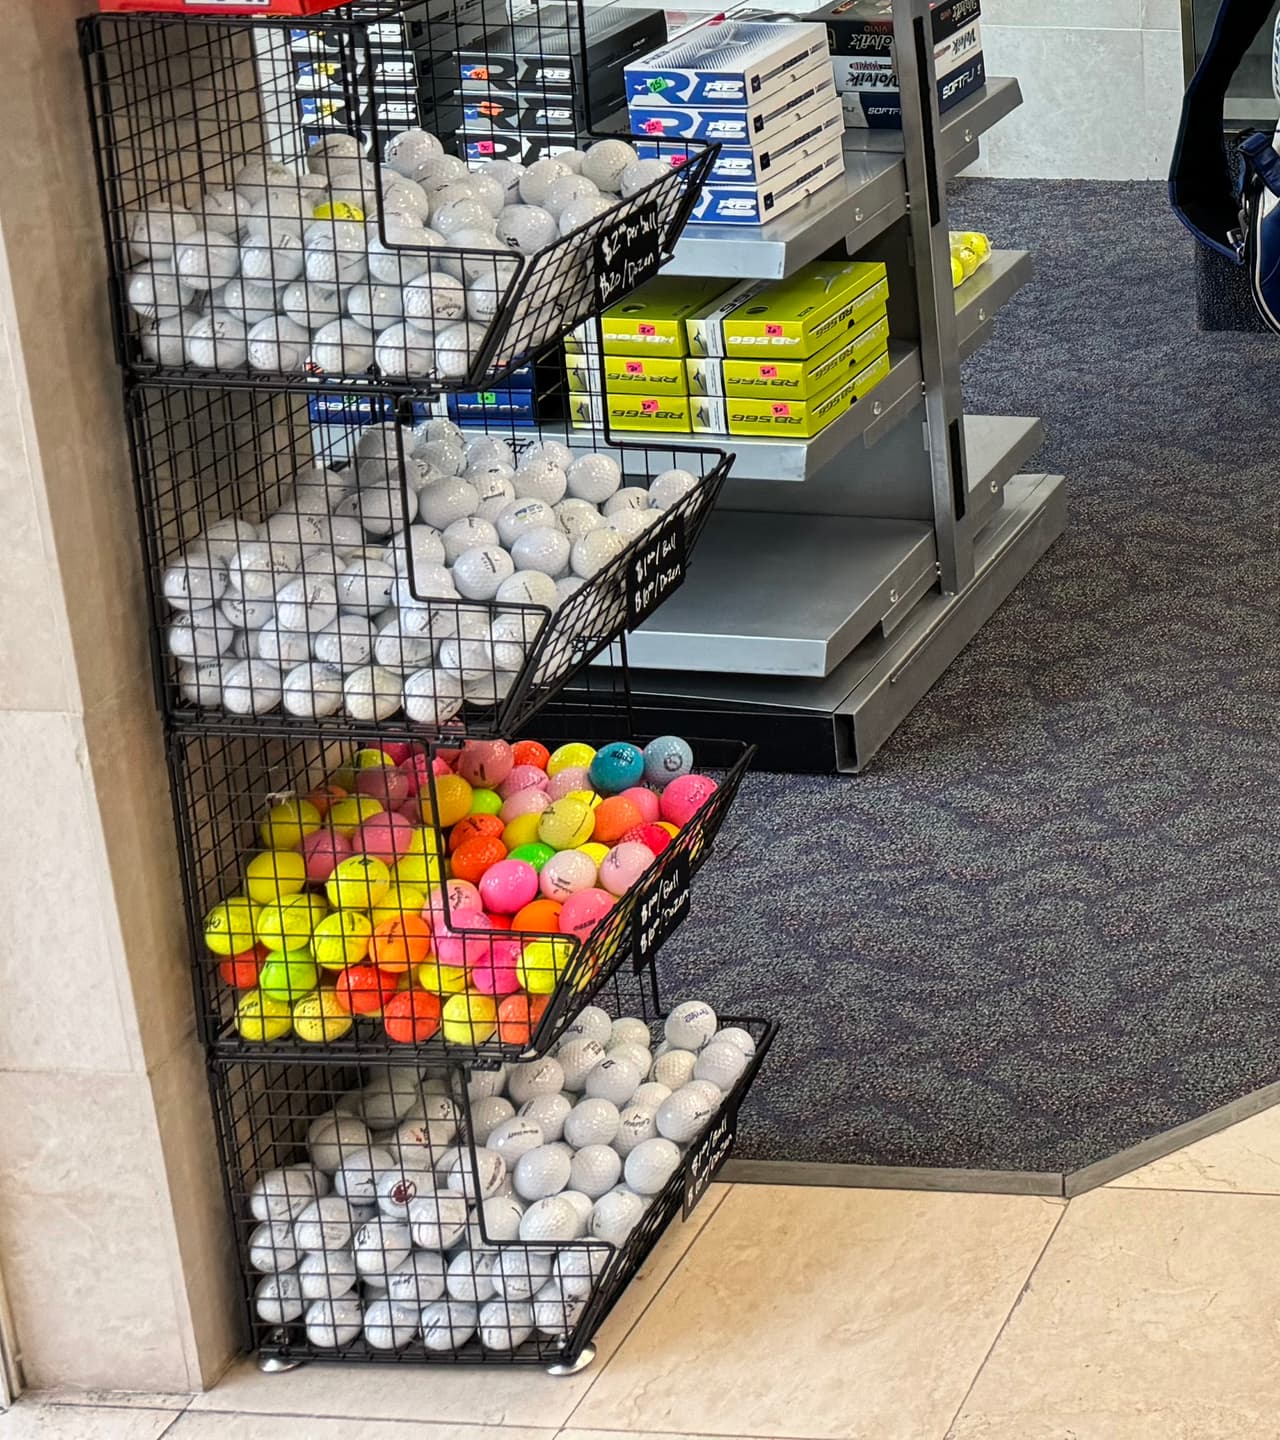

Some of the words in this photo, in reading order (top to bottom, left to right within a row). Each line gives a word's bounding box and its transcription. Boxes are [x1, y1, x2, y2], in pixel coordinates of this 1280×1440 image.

[851, 33, 895, 50] olvik
[847, 71, 900, 88] Volvik
[626, 224, 639, 247] per
[640, 211, 657, 235] ball
